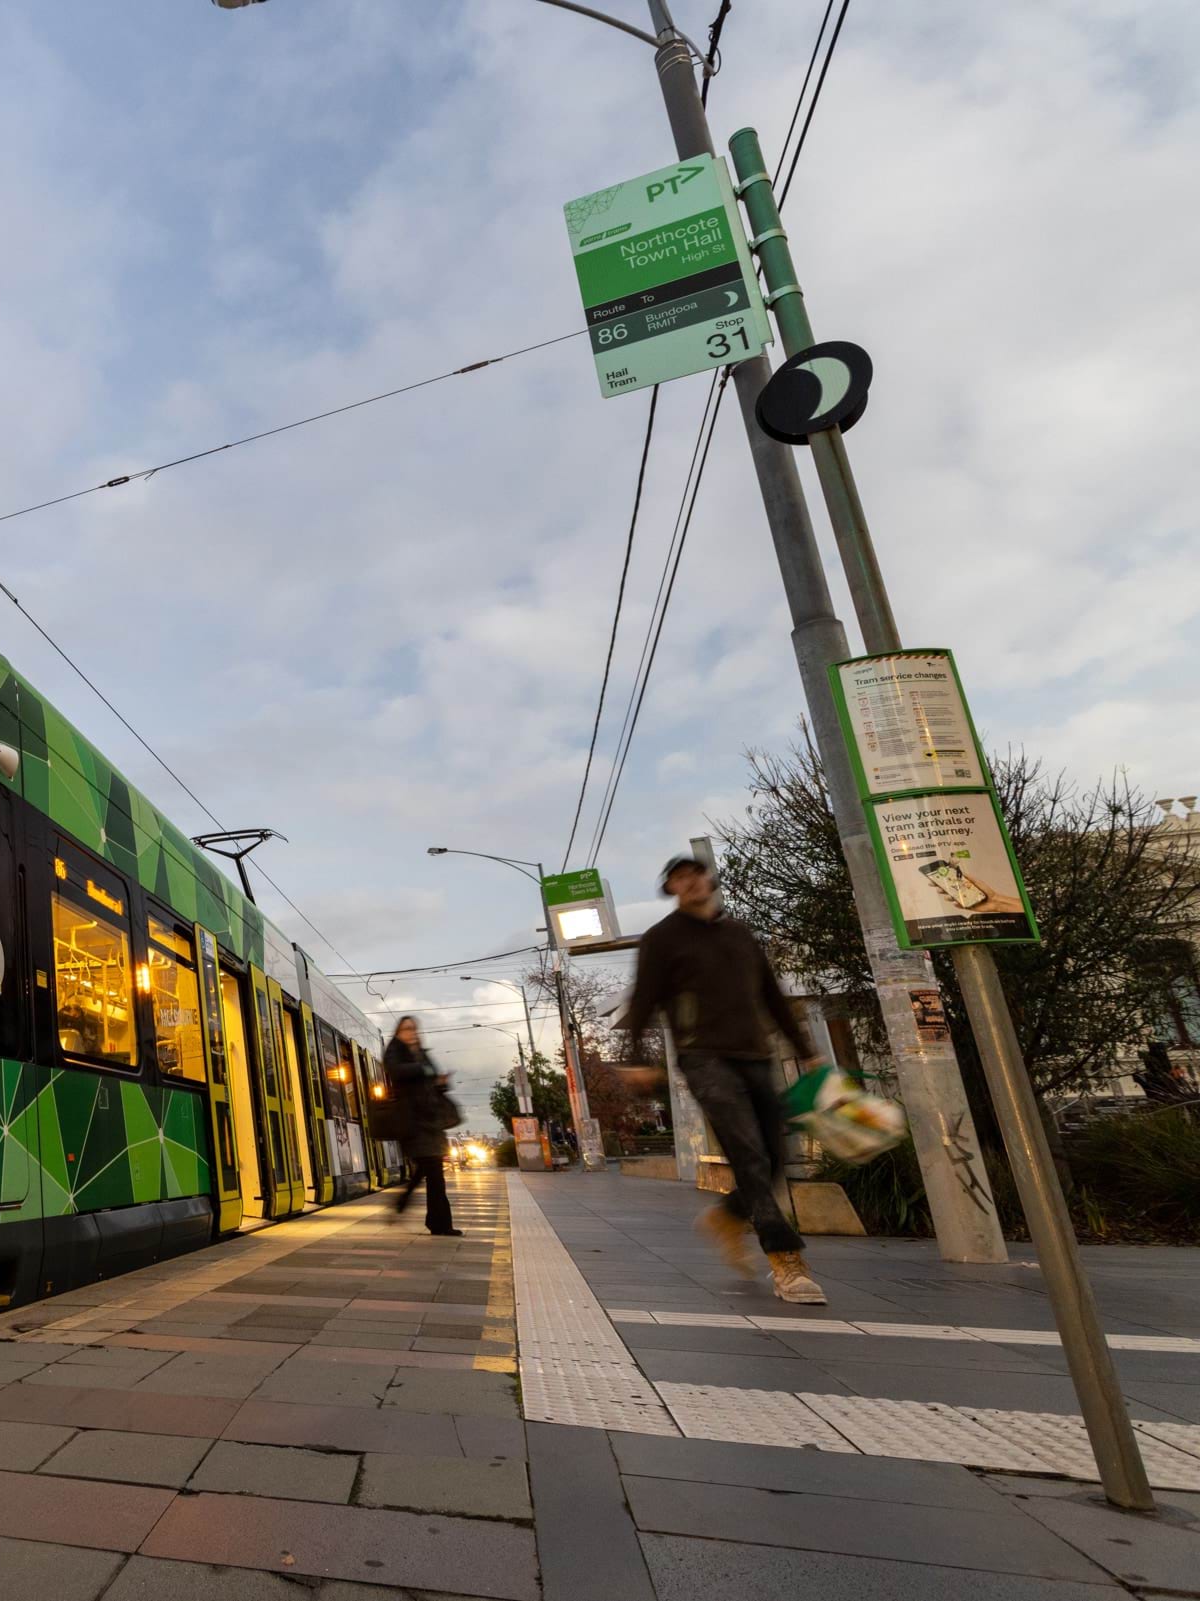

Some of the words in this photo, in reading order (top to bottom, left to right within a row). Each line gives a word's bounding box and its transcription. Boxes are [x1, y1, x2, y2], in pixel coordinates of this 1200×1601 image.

[620, 217, 719, 257] Northcote
[625, 245, 677, 269] Town
[684, 229, 722, 250] Hall
[681, 248, 709, 264] High
[713, 243, 726, 254] St
[593, 304, 626, 319] Route
[640, 295, 655, 304] To
[647, 316, 678, 332] RMIT
[715, 317, 744, 330] Stop
[598, 323, 628, 345] 86
[706, 326, 750, 359] 31
[606, 368, 629, 381] Hail
[607, 376, 637, 389] Tram
[855, 677, 878, 686] Tram
[880, 673, 913, 681] service
[914, 672, 947, 680] changes
[882, 812, 912, 823] View
[915, 809, 941, 820] your
[945, 806, 971, 815] next
[885, 822, 915, 833] tram
[918, 817, 962, 828] arrivals
[888, 831, 914, 845] plan
[926, 827, 973, 839] journey.
